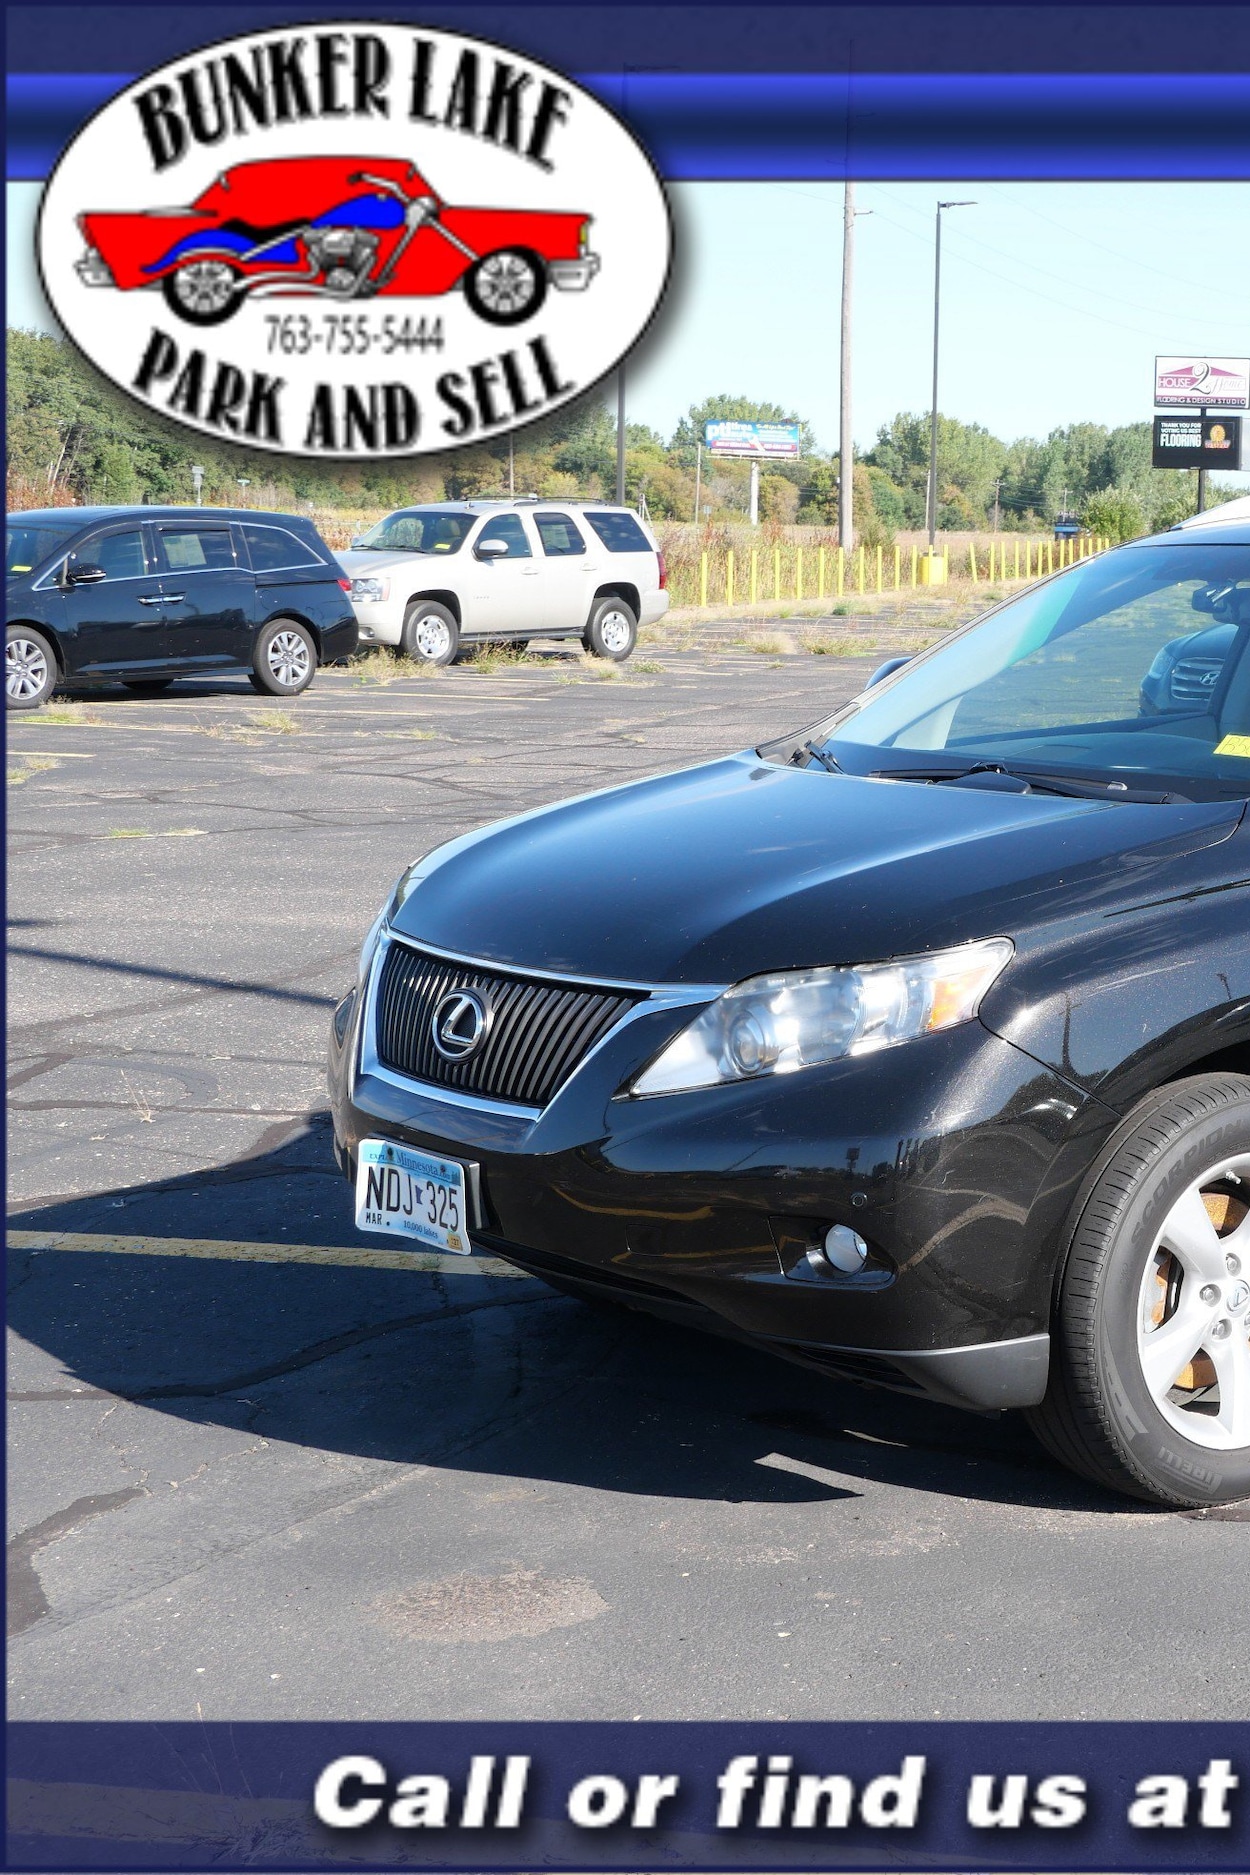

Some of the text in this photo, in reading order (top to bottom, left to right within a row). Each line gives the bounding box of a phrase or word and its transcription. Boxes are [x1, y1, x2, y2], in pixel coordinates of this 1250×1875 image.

[1160, 377, 1191, 388] HOUSE
[1190, 362, 1211, 394] 2
[1160, 434, 1202, 448] FLOORING
[1131, 1119, 1245, 1244] SCORPION
[366, 1166, 459, 1232] NDJ 325
[366, 1212, 383, 1225] MAR
